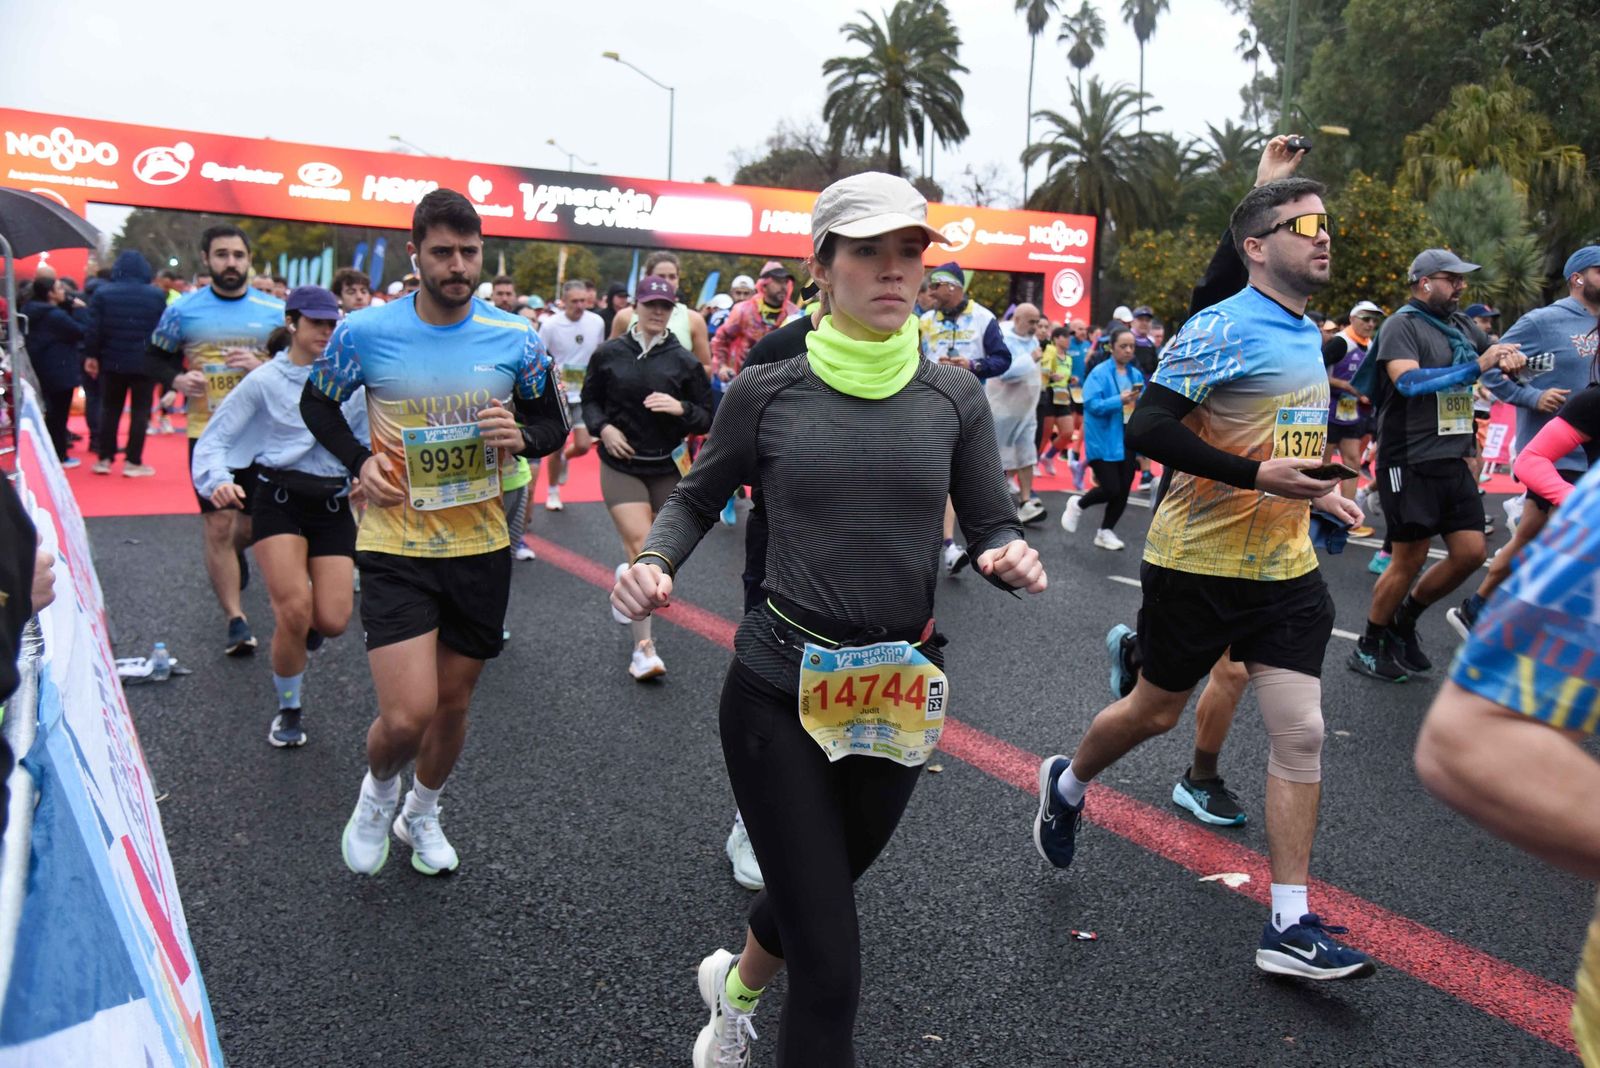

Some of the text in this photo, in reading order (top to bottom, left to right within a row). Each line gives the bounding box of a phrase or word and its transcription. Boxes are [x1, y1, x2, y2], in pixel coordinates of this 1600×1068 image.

[402, 389, 490, 415] MEDIO
[420, 444, 478, 473] 9937
[863, 653, 903, 666] sevilla
[813, 672, 926, 710] 14744
[860, 707, 880, 715] Judit
